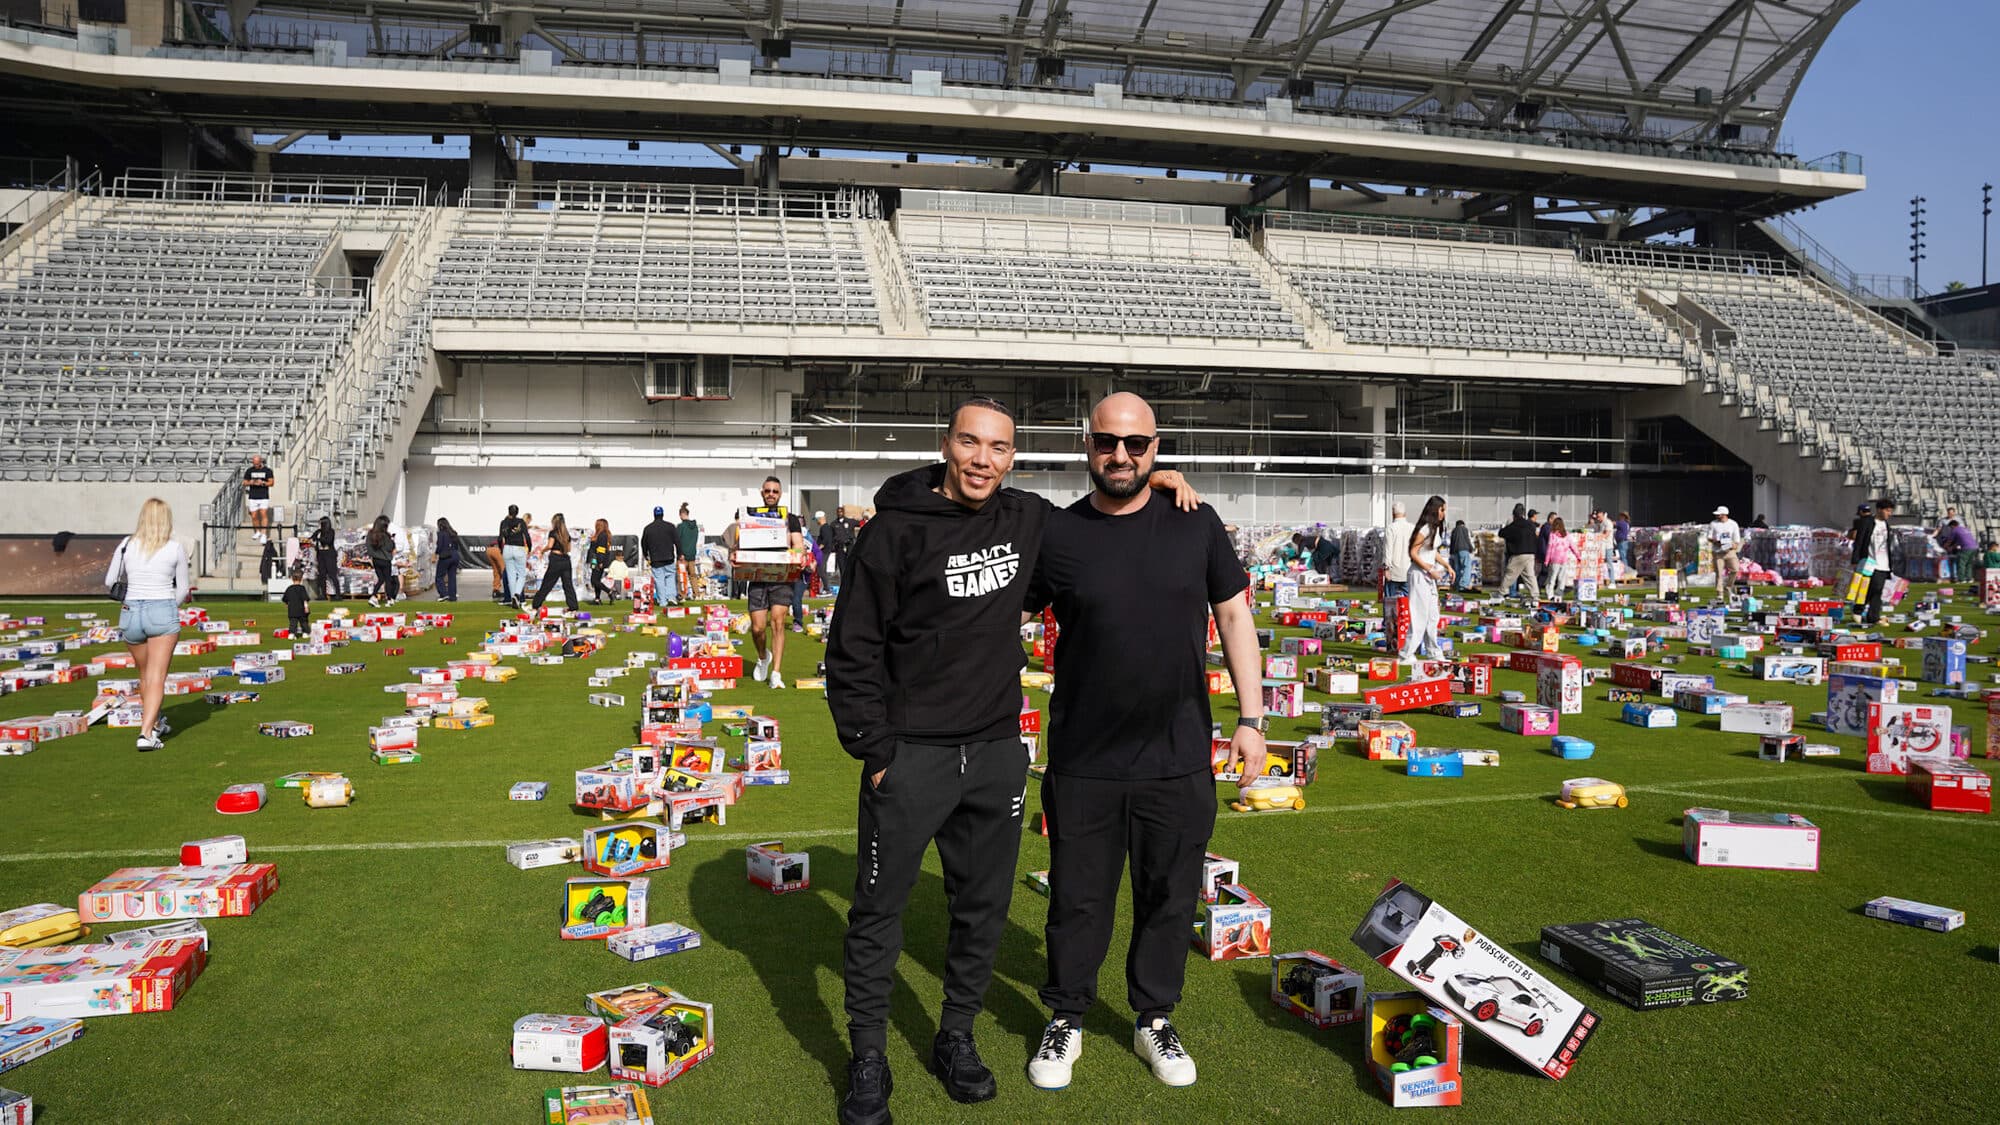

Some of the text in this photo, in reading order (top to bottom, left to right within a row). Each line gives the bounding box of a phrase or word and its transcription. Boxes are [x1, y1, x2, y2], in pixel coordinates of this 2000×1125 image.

[946, 542, 1012, 568] REALTY
[946, 560, 1020, 598] GAMES
[691, 661, 734, 669] TYSON
[1390, 685, 1440, 699] TYSON
[1400, 694, 1432, 706] MIKE
[1215, 912, 1240, 923] VENOM
[1221, 914, 1254, 927] TUMBLER
[567, 925, 593, 934] VENOM
[575, 927, 608, 937] TUMBLER
[1475, 937, 1533, 981] PORSCHE GT3 RS
[1645, 989, 1693, 1002] STRIKER-X
[1400, 1078, 1435, 1092] VENOM
[1410, 1081, 1456, 1098] TUMBLER
